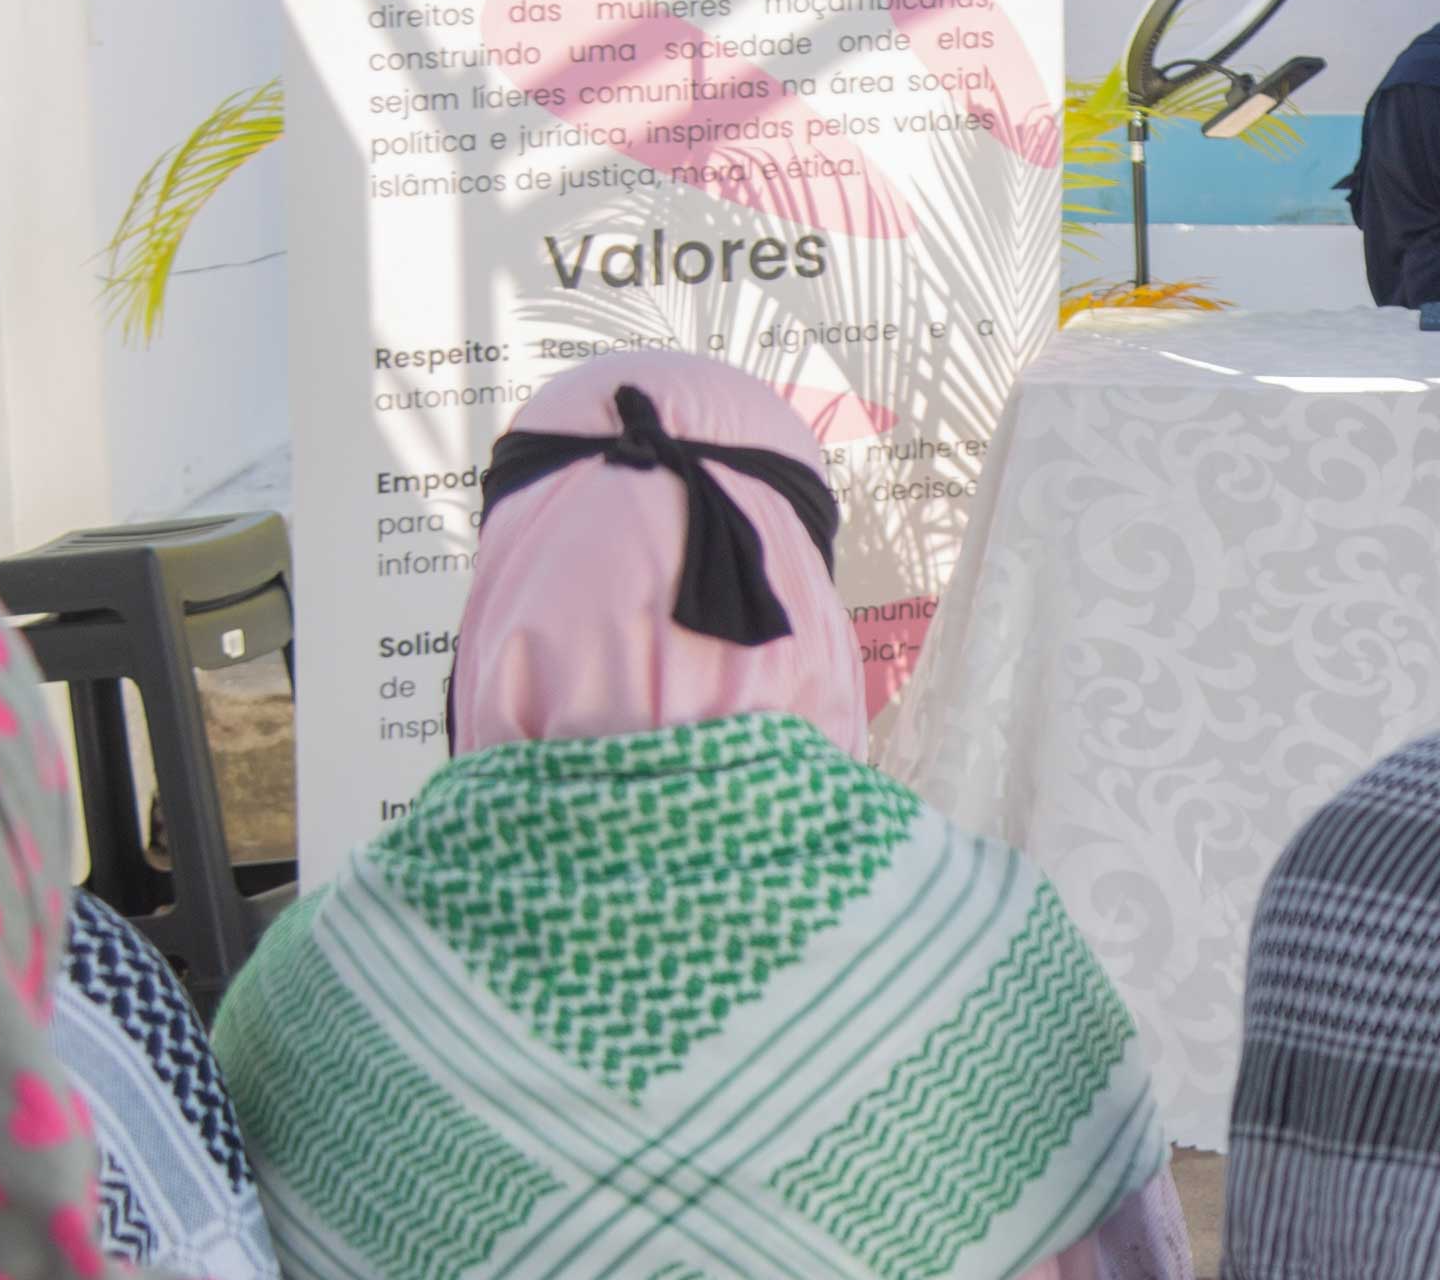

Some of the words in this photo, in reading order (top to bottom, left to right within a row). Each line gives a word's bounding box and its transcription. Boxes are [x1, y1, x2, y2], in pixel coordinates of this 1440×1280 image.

[368, 2, 475, 31] direitos
[368, 41, 542, 74] construindo
[569, 40, 637, 65] uma
[665, 32, 813, 61] sociedade
[837, 27, 911, 54] onde
[937, 26, 995, 51] elas
[369, 84, 459, 121] sejam
[471, 80, 566, 110] líderes
[578, 73, 770, 107] comunitárias
[781, 76, 816, 98] na
[830, 67, 894, 96] área
[907, 68, 996, 96] social,
[371, 125, 477, 163] política
[490, 131, 507, 153] e
[519, 119, 634, 157] jurídica,
[645, 115, 794, 152] inspiradas
[804, 111, 880, 144] pelos
[893, 105, 995, 132] valores
[371, 167, 506, 199] islâmicos
[515, 165, 552, 192] de
[559, 162, 663, 197] justiça,
[671, 155, 753, 184] moral
[762, 162, 779, 181] e
[786, 154, 862, 179] ética.
[545, 228, 827, 291] Valores
[376, 339, 509, 374] Respeito:
[707, 333, 726, 352] a
[759, 319, 899, 354] dignidade
[929, 319, 946, 339] e
[976, 317, 994, 337] a
[378, 512, 444, 543] para
[380, 676, 416, 699] de
[380, 712, 446, 744] inspi
